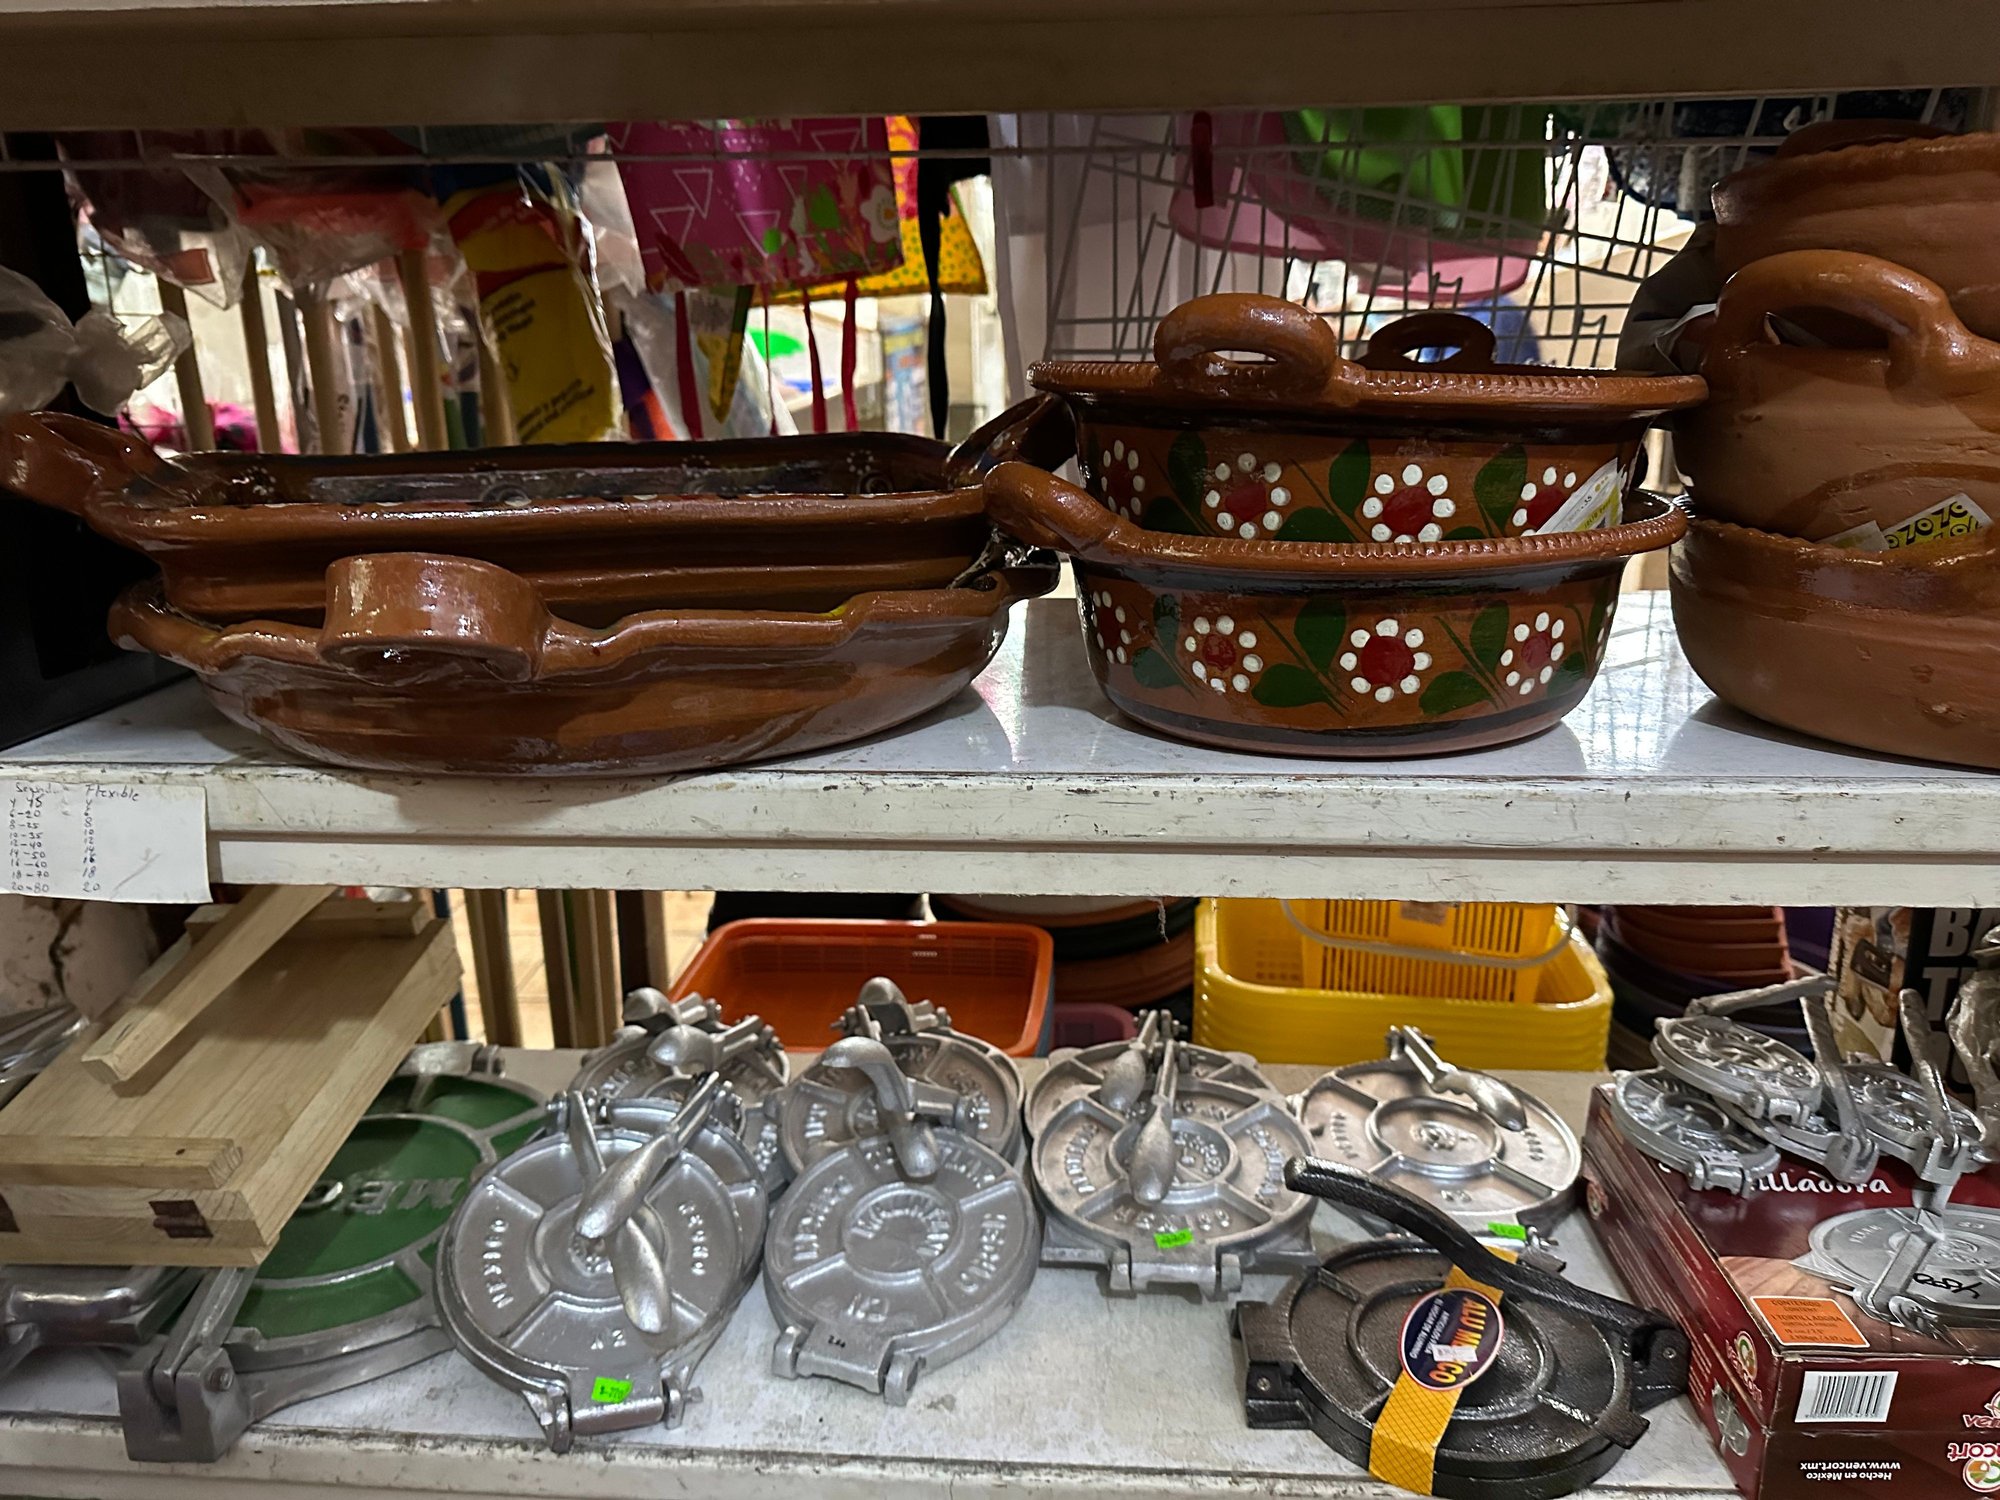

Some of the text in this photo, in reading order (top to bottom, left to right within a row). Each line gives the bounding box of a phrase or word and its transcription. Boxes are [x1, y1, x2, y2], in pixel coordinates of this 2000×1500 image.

[85, 784, 139, 801] Flexible
[82, 881, 100, 893] 20
[1800, 1462, 1901, 1471] www.vencort.mx
[1806, 1472, 1893, 1481] Hecho en México
